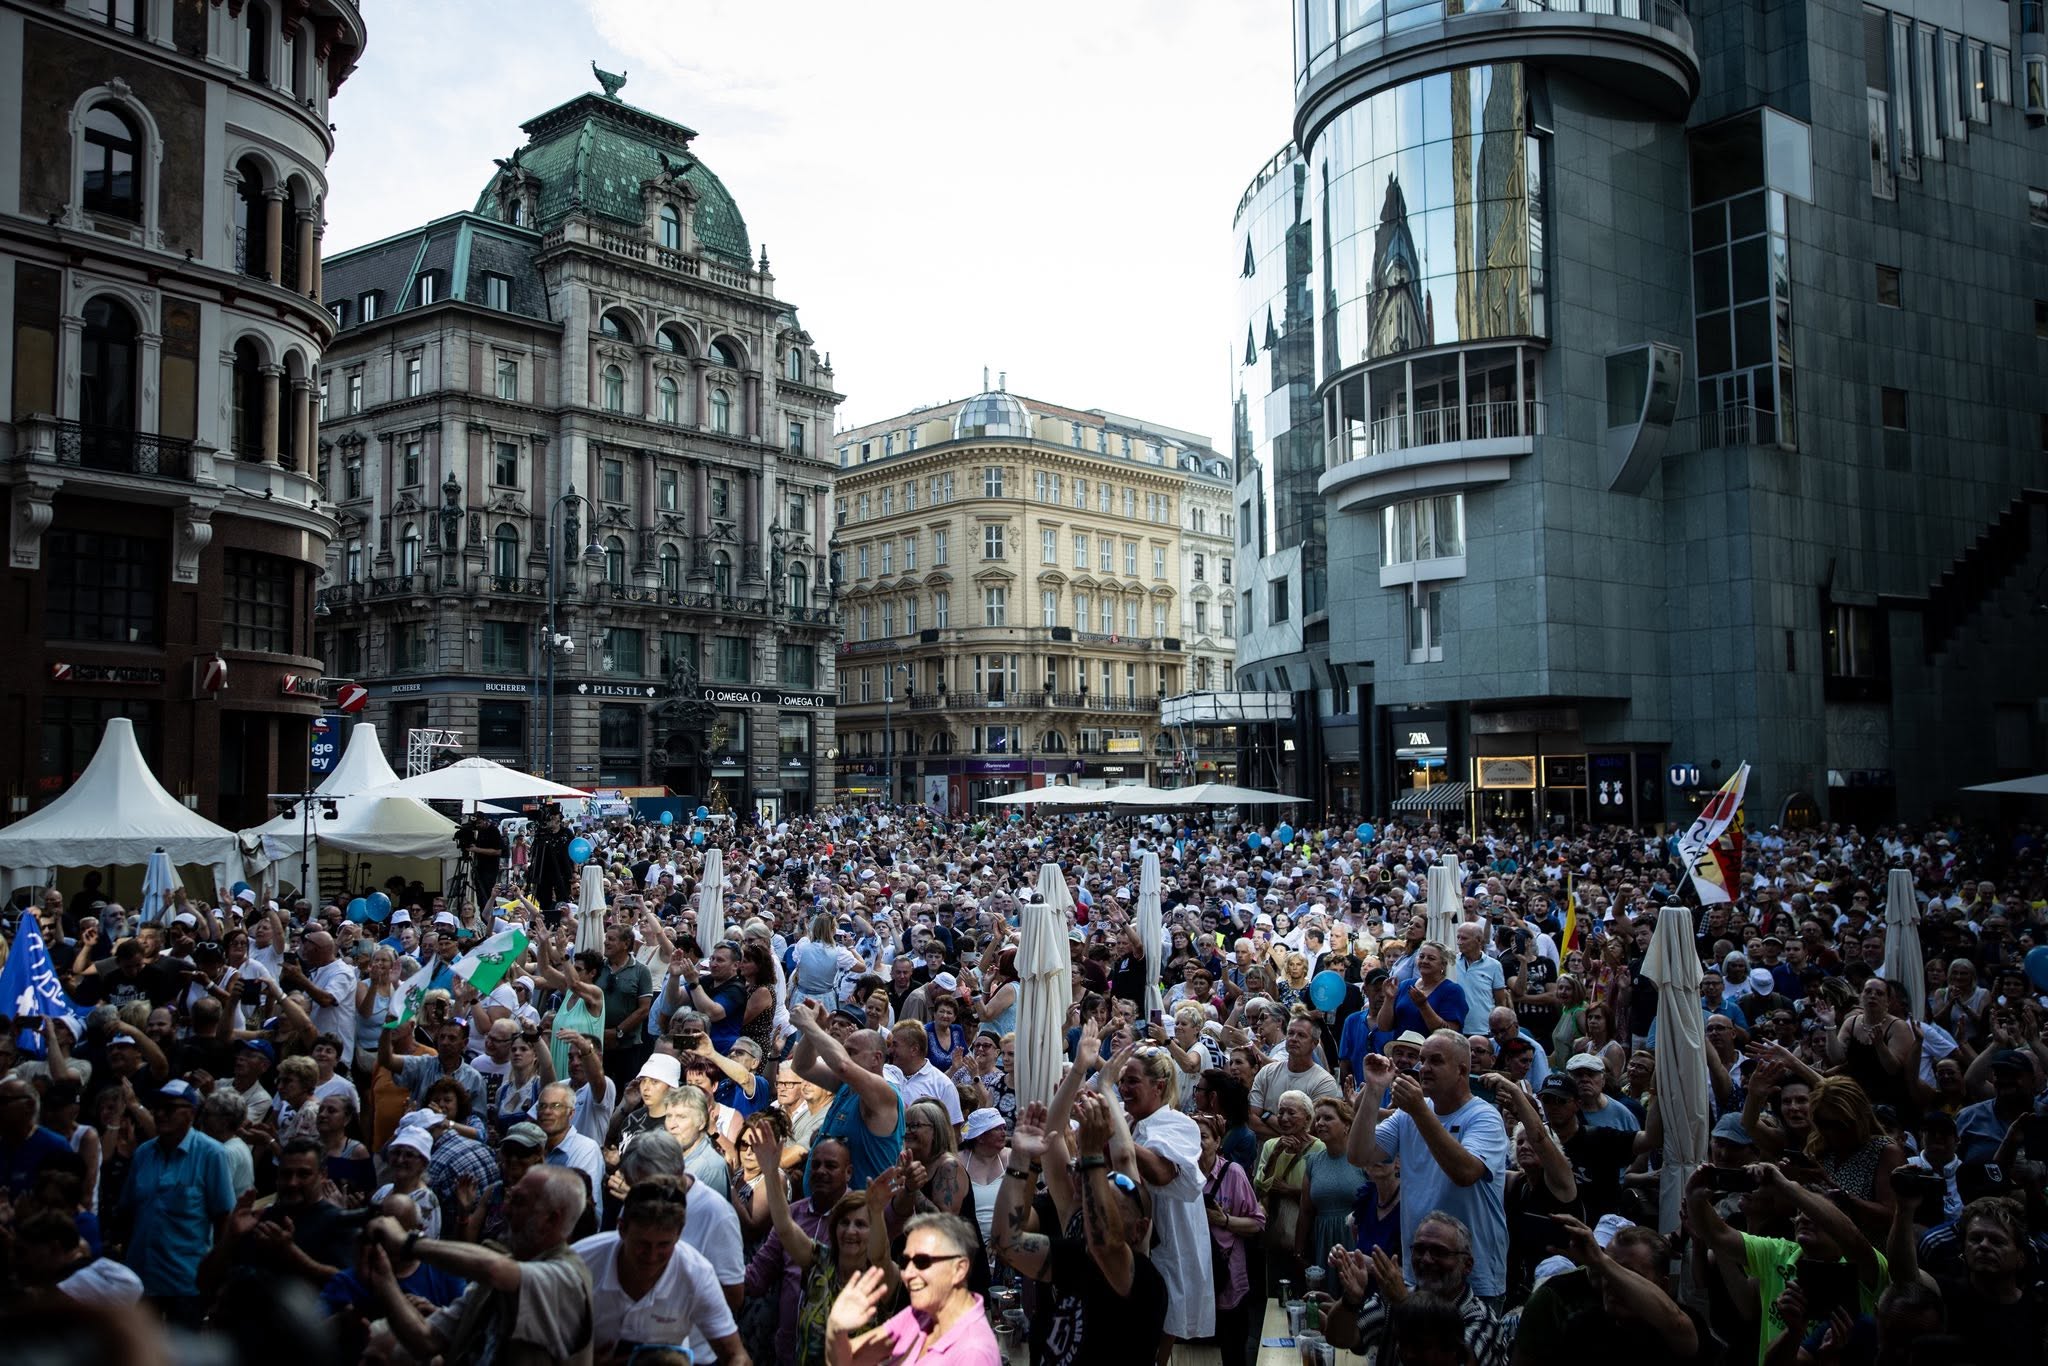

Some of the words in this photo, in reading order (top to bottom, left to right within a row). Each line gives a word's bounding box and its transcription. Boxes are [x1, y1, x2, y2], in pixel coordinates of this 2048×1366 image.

[391, 683, 421, 693] BUCHERER
[485, 683, 526, 692] BUCHERER
[593, 685, 642, 697] PILSTL
[717, 691, 749, 702] OMEGA
[784, 696, 813, 706] OMEGA
[1408, 732, 1431, 745] ZARA
[1670, 768, 1686, 786] U
[1690, 768, 1700, 786] U
